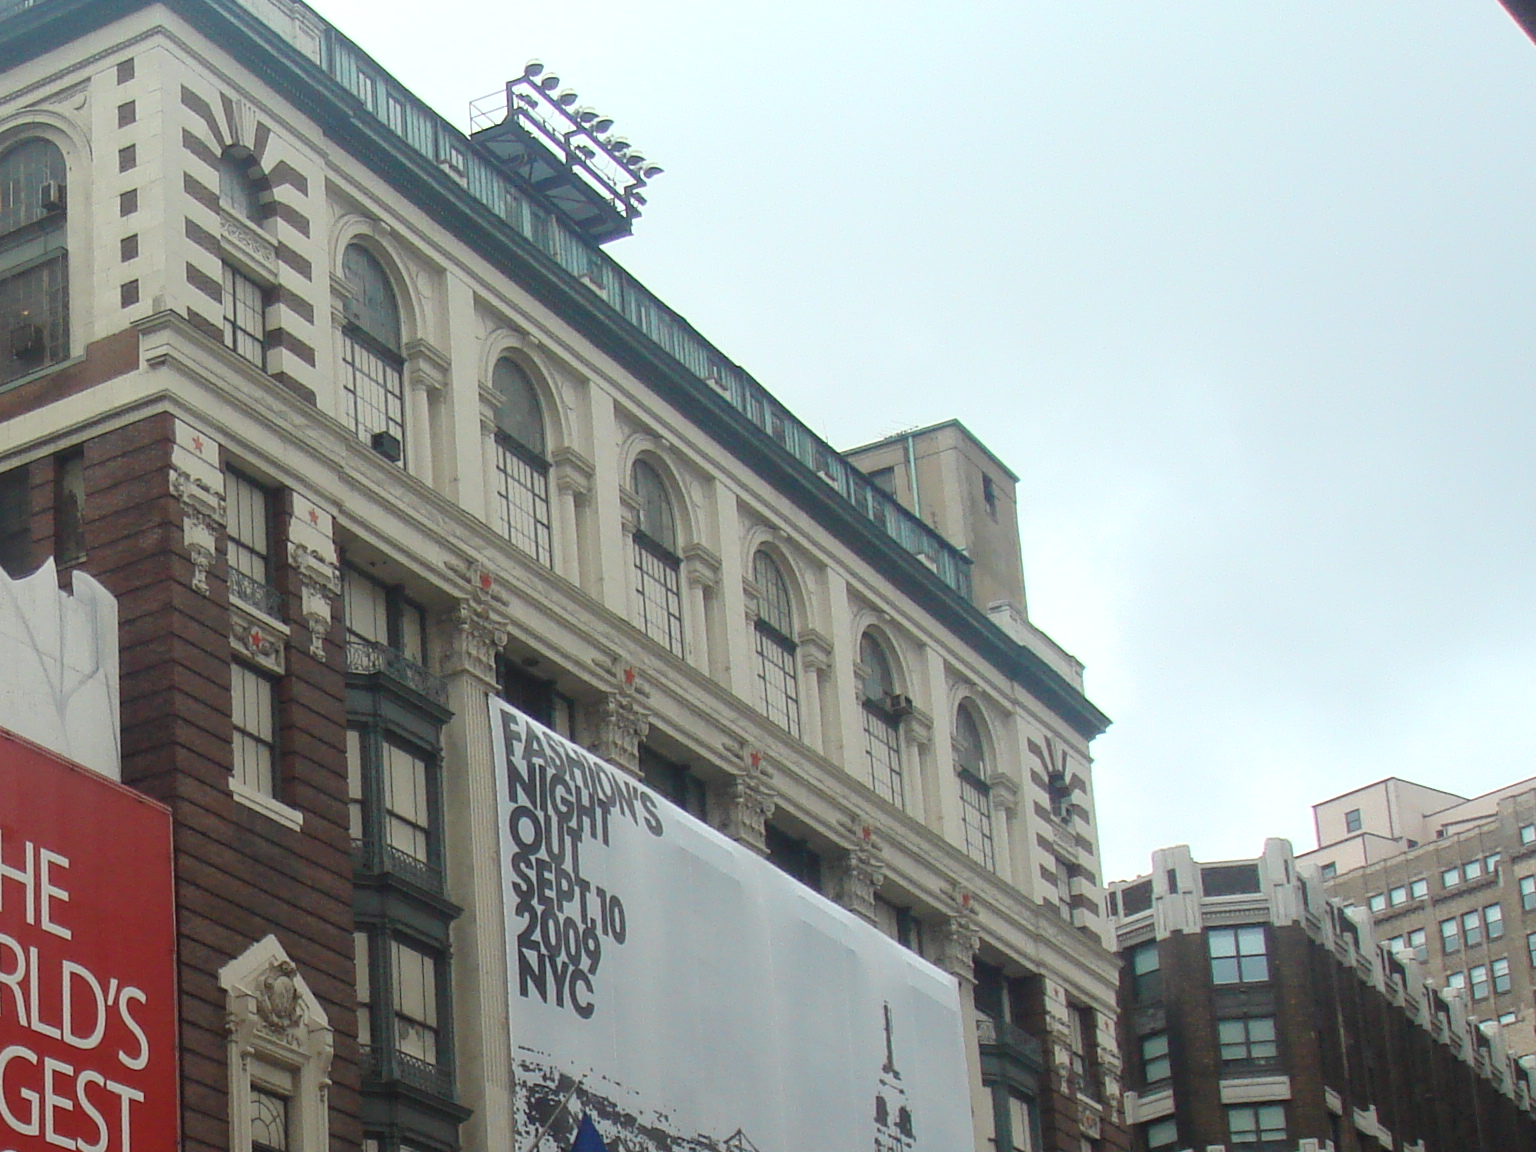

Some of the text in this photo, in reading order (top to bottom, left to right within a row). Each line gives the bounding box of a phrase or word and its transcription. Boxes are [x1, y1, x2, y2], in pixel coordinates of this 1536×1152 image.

[500, 708, 664, 838] FASHION'S
[506, 758, 611, 848] NIGHT
[509, 805, 582, 880] OUT
[515, 899, 602, 976] 2009
[596, 886, 627, 945] 10
[517, 948, 596, 1020] NYC
